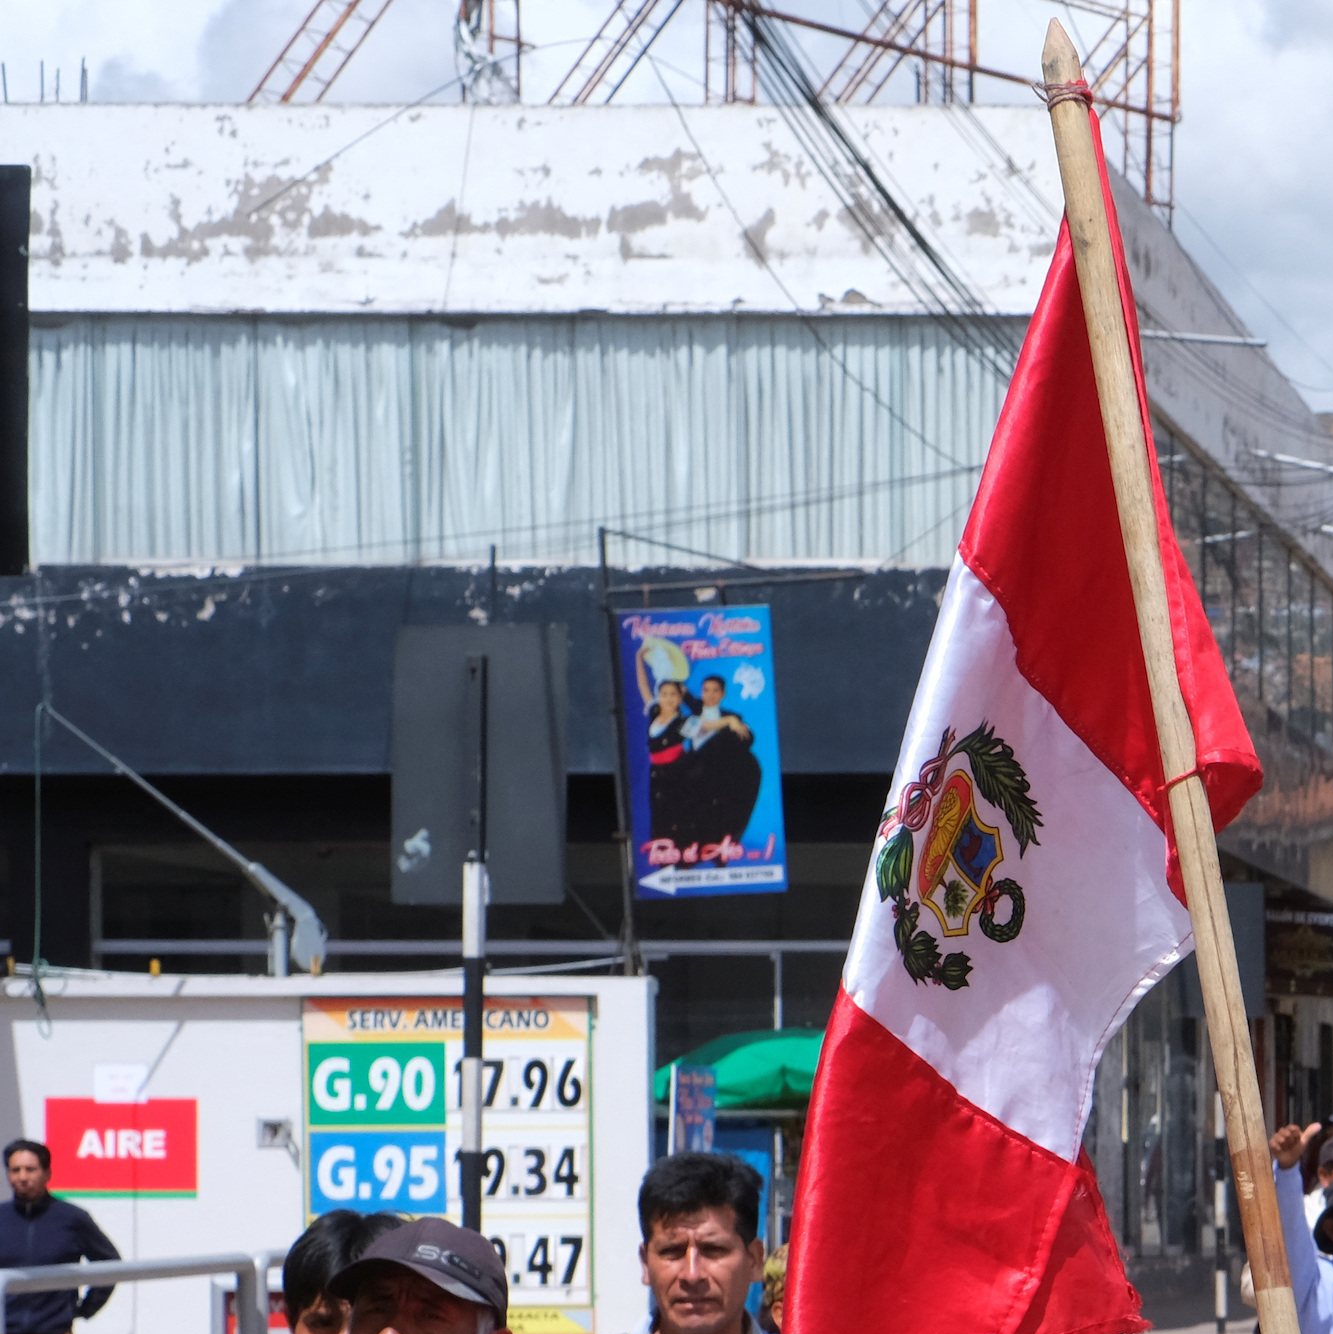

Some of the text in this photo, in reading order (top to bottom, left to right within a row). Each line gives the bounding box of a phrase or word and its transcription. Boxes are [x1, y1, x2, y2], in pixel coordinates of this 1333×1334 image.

[347, 1009, 550, 1031] SERV. AMECANO
[312, 1056, 436, 1112] G.90
[77, 1129, 167, 1159] AIRE
[317, 1145, 439, 1200] G.95
